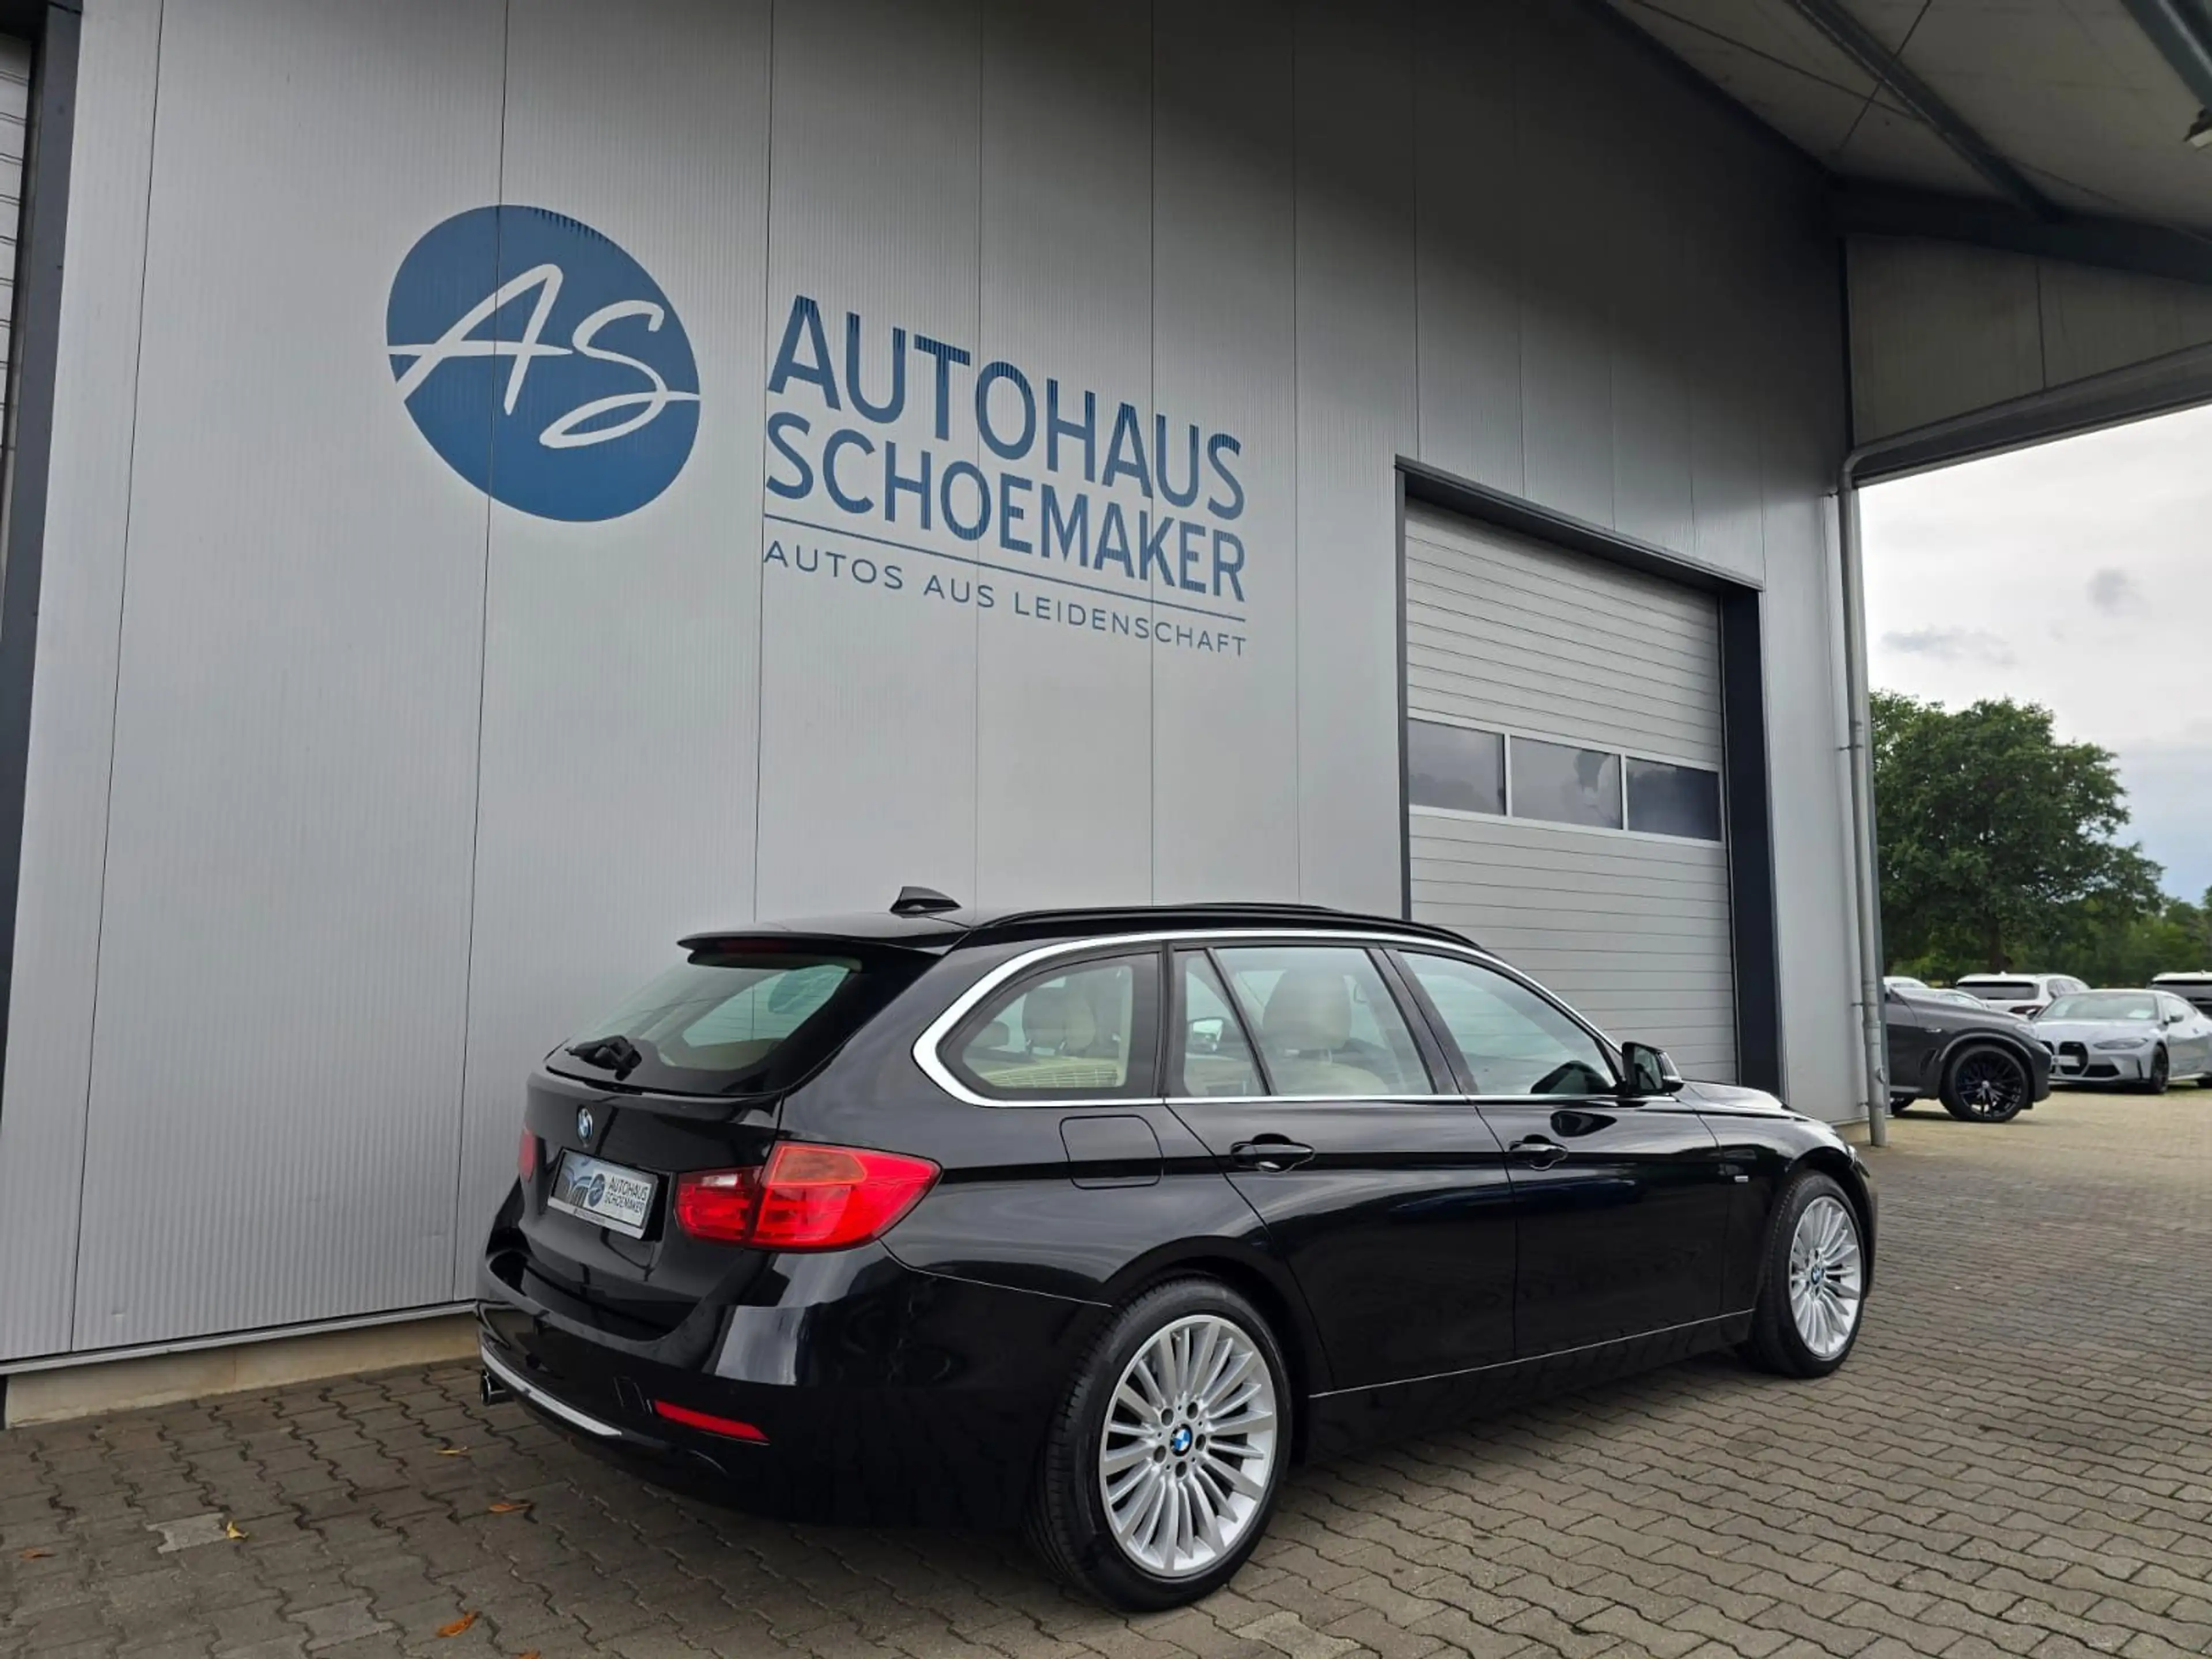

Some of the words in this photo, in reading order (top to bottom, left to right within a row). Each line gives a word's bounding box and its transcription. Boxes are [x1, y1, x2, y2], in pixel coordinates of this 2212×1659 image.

[387, 263, 700, 449] AS
[767, 294, 1245, 521] AUTOHAUS
[763, 540, 904, 590] AUTOS
[923, 575, 995, 608] AUS
[1014, 592, 1247, 657] LEIDENSCHAFT
[766, 410, 1247, 602] SCHOEMAKER
